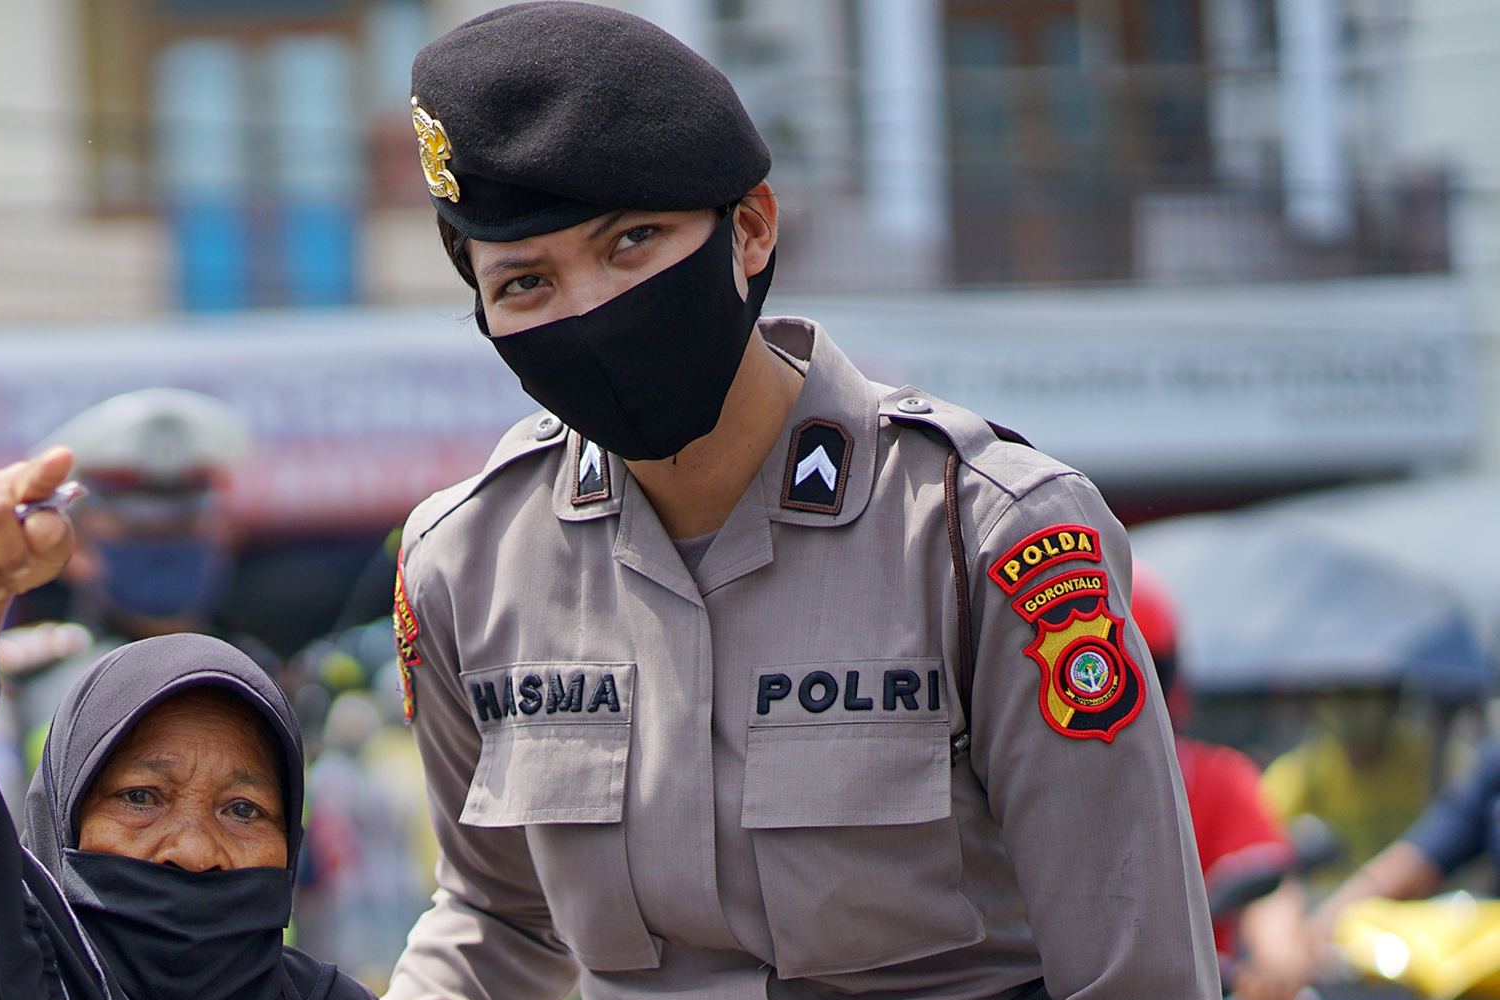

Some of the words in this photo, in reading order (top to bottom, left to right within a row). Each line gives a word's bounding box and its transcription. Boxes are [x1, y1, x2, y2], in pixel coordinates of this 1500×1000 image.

[1003, 532, 1092, 582] POLDA
[1024, 576, 1102, 612] GORONTALO
[471, 674, 621, 721] HASMA
[757, 670, 941, 715] POLRI
